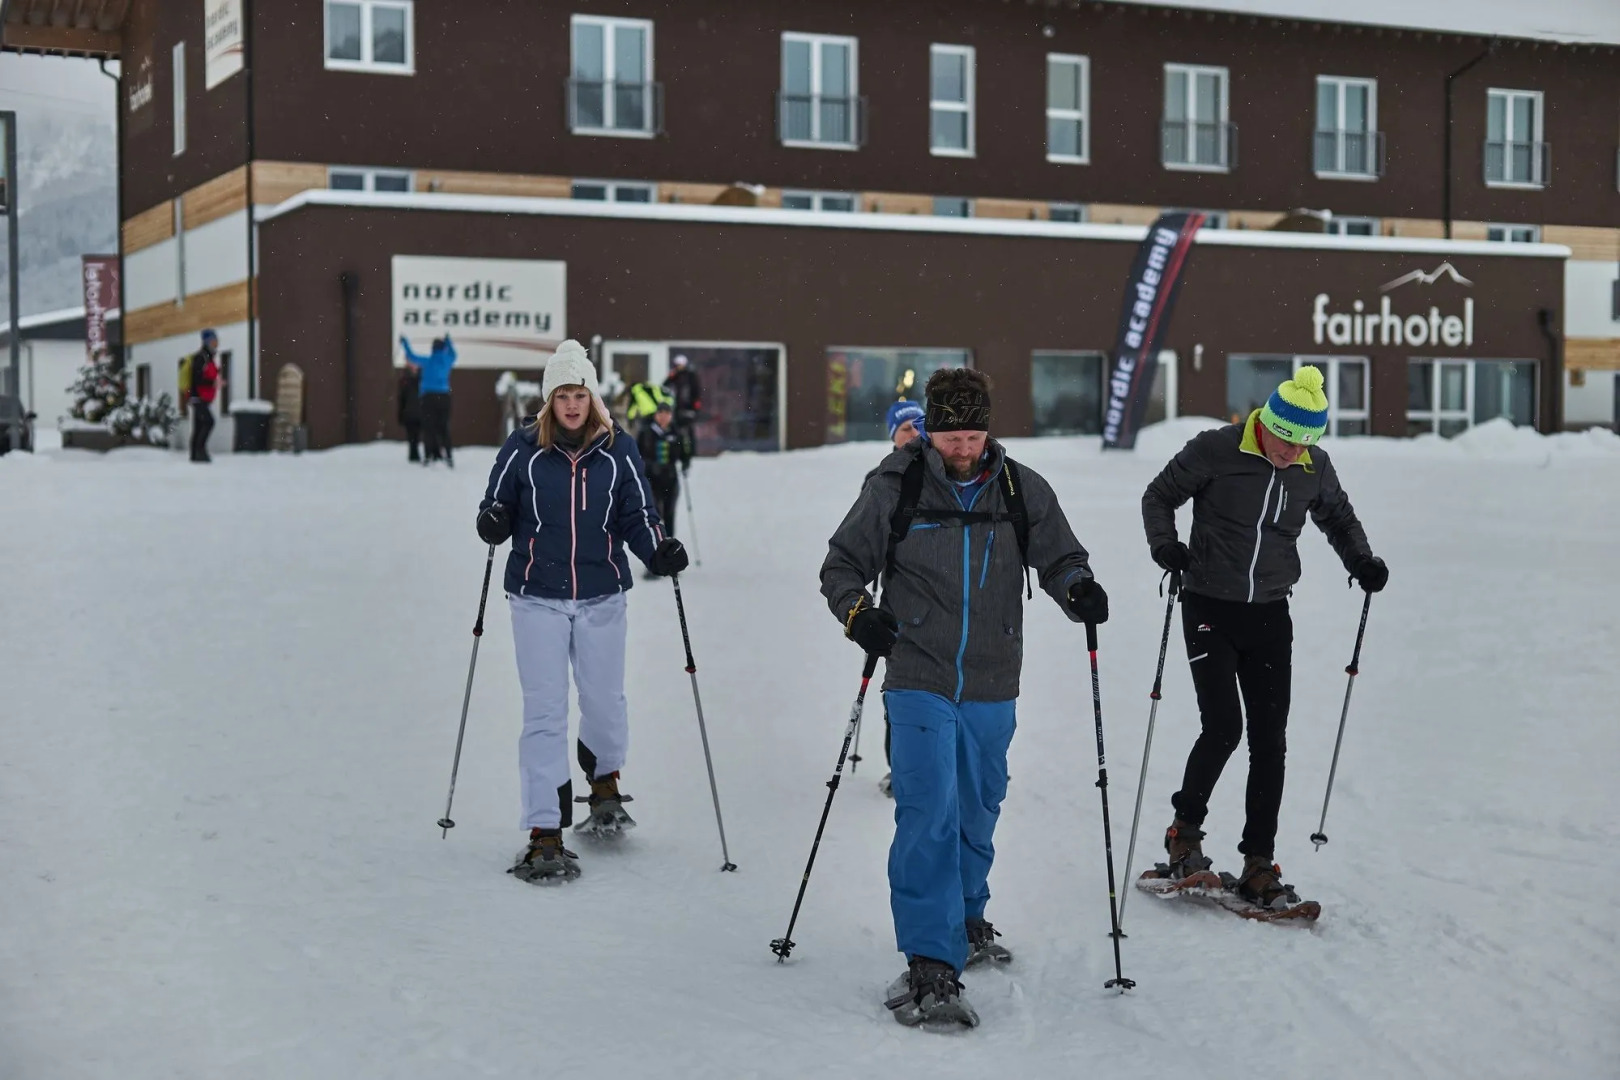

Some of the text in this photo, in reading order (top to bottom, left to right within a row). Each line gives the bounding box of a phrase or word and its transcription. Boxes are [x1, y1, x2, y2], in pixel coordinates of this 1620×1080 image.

[403, 281, 513, 301] nordic
[403, 306, 552, 333] academy
[1103, 227, 1178, 442] nordic academy
[1312, 293, 1474, 347] fairhotel
